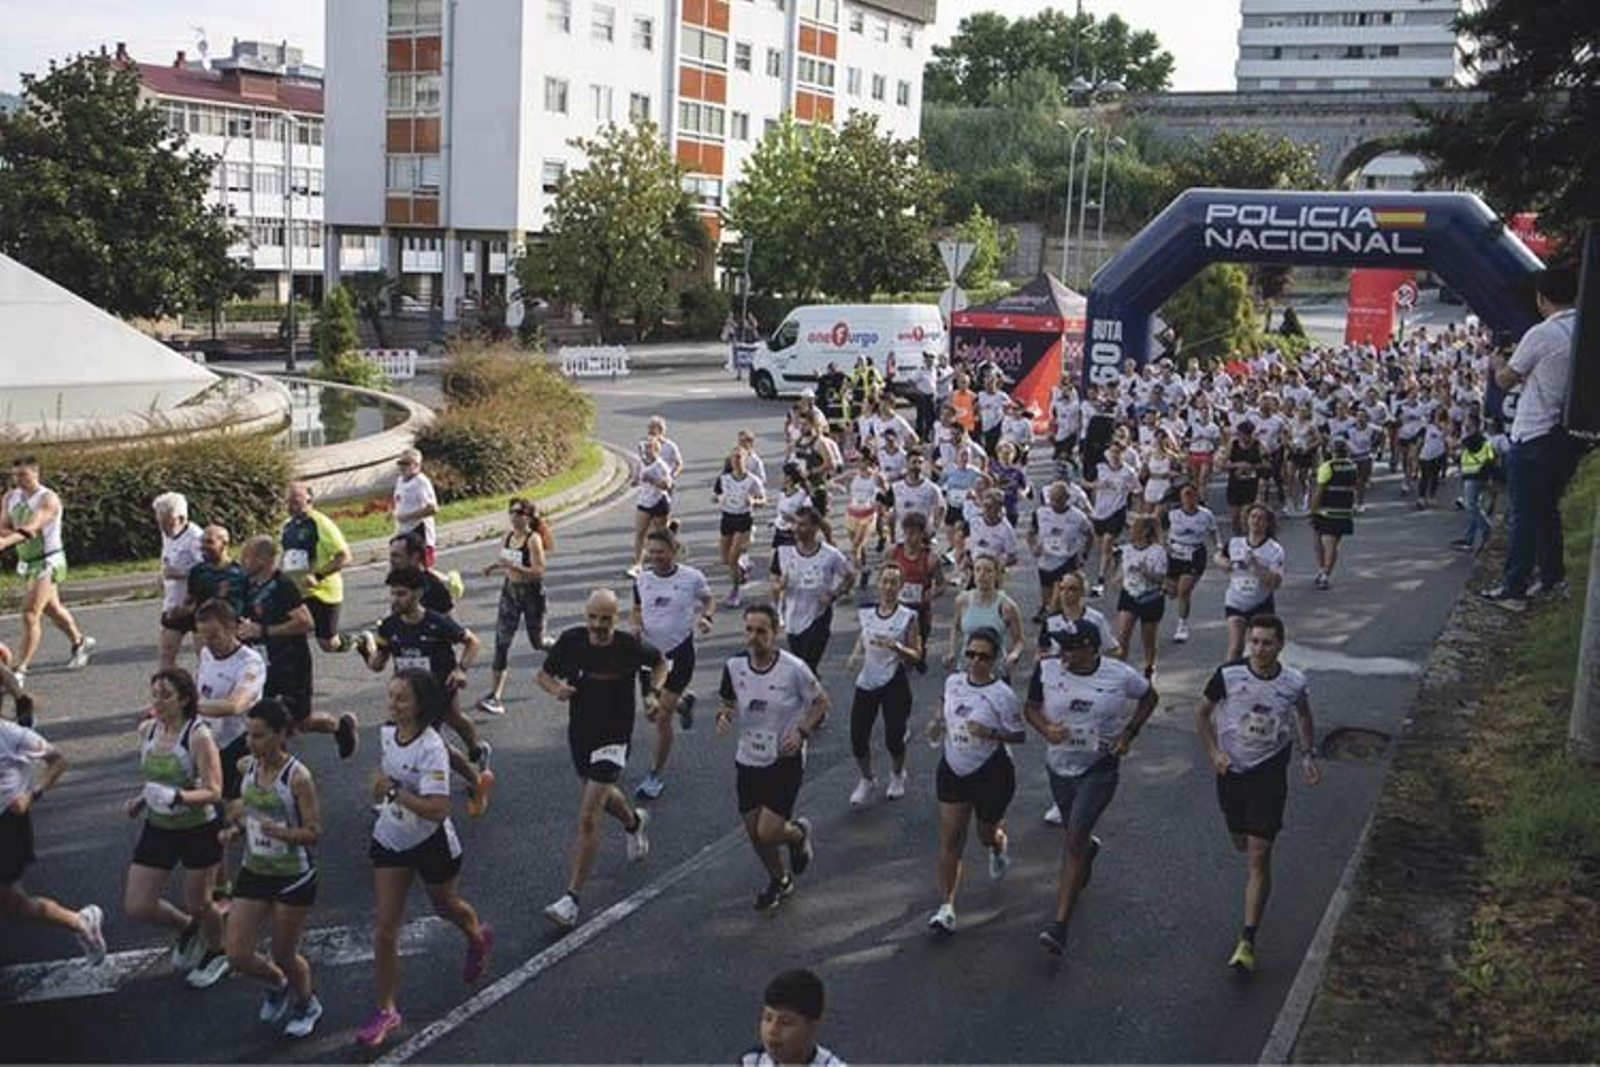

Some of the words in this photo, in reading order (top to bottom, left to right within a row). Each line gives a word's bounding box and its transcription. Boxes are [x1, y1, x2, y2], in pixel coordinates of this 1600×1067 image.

[1204, 203, 1378, 229] POLICIA
[1204, 227, 1425, 255] NACIONAL
[1092, 318, 1123, 342] RUTA
